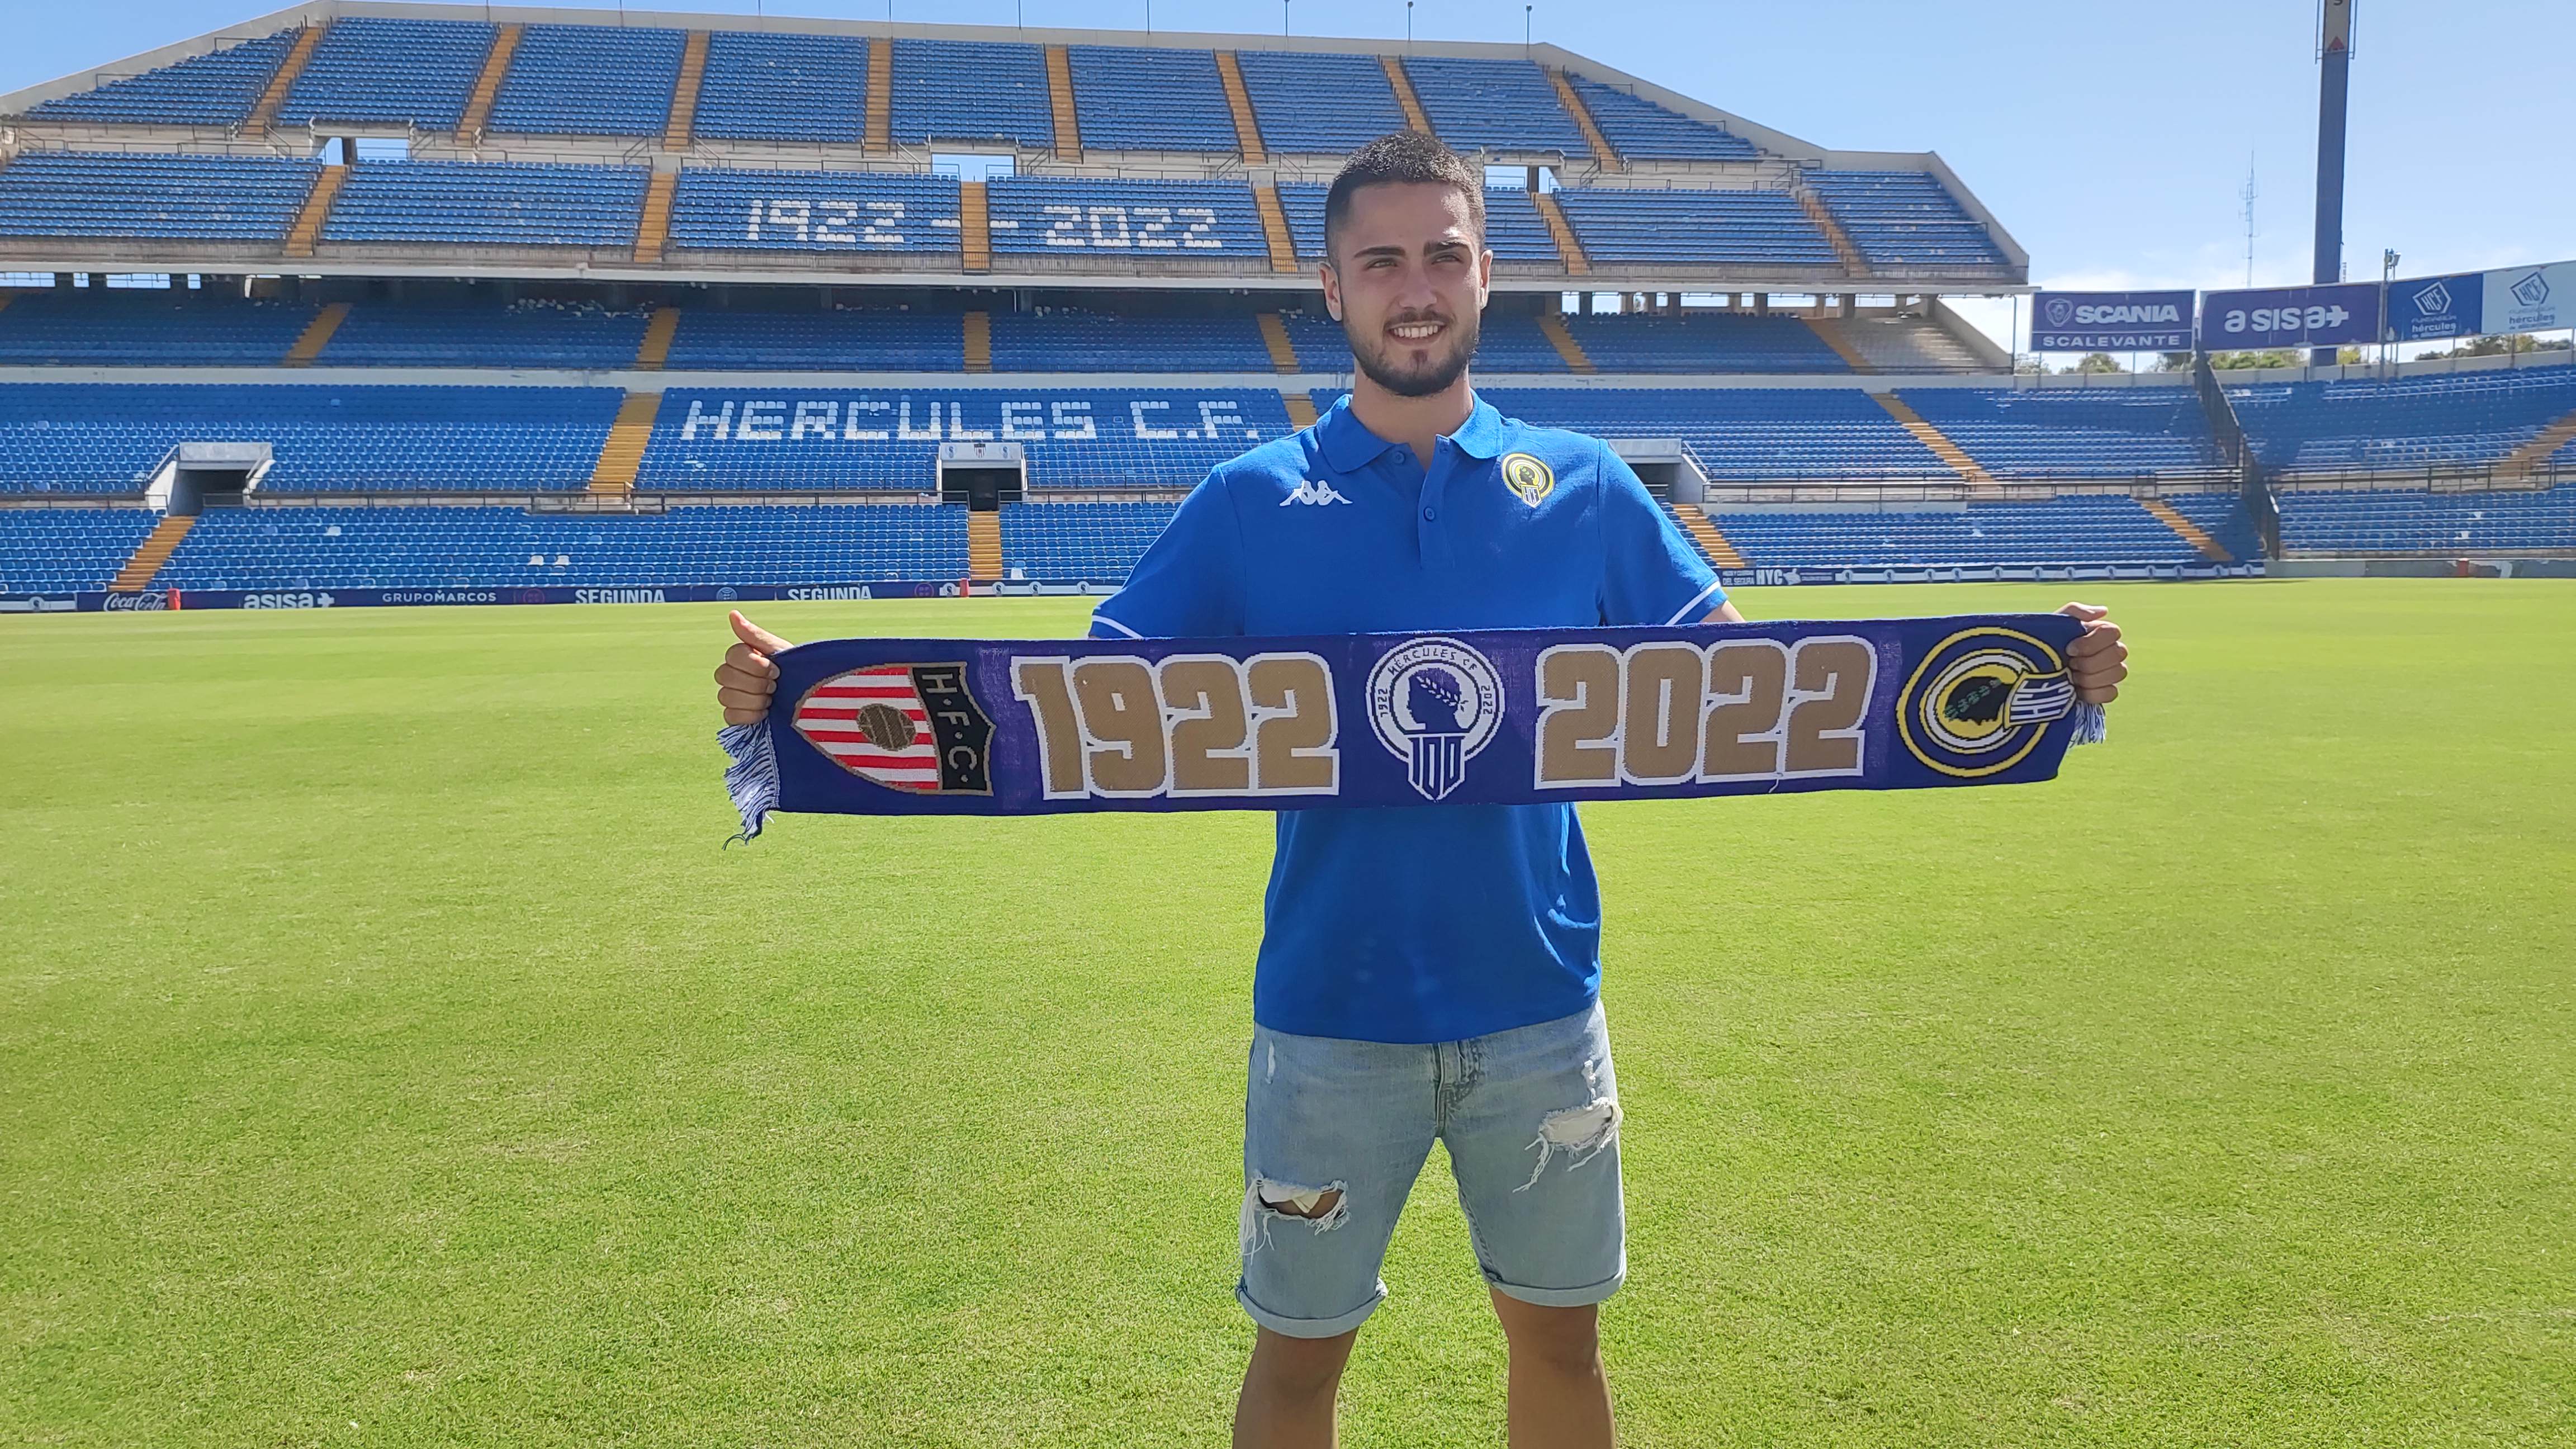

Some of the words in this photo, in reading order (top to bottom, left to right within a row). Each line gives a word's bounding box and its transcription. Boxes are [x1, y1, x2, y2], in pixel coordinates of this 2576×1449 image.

[747, 200, 905, 243] 1922
[1044, 206, 1222, 248] 2022
[2421, 288, 2442, 311] HCF
[2518, 278, 2542, 302] HCF
[2075, 305, 2180, 324] SCANIA
[2043, 335, 2180, 347] SCALEVANTE
[680, 400, 1098, 441] HERCULES
[1755, 569, 1783, 585] HYC
[382, 590, 497, 603] GRUPOMARCOS
[575, 589, 666, 604] SEGUNDA
[788, 585, 873, 600] SEGUNDA
[1377, 688, 1389, 718] 1922
[1481, 685, 1493, 715] 2022
[1533, 634, 1878, 789] 2022
[1009, 651, 1340, 801] 1922
